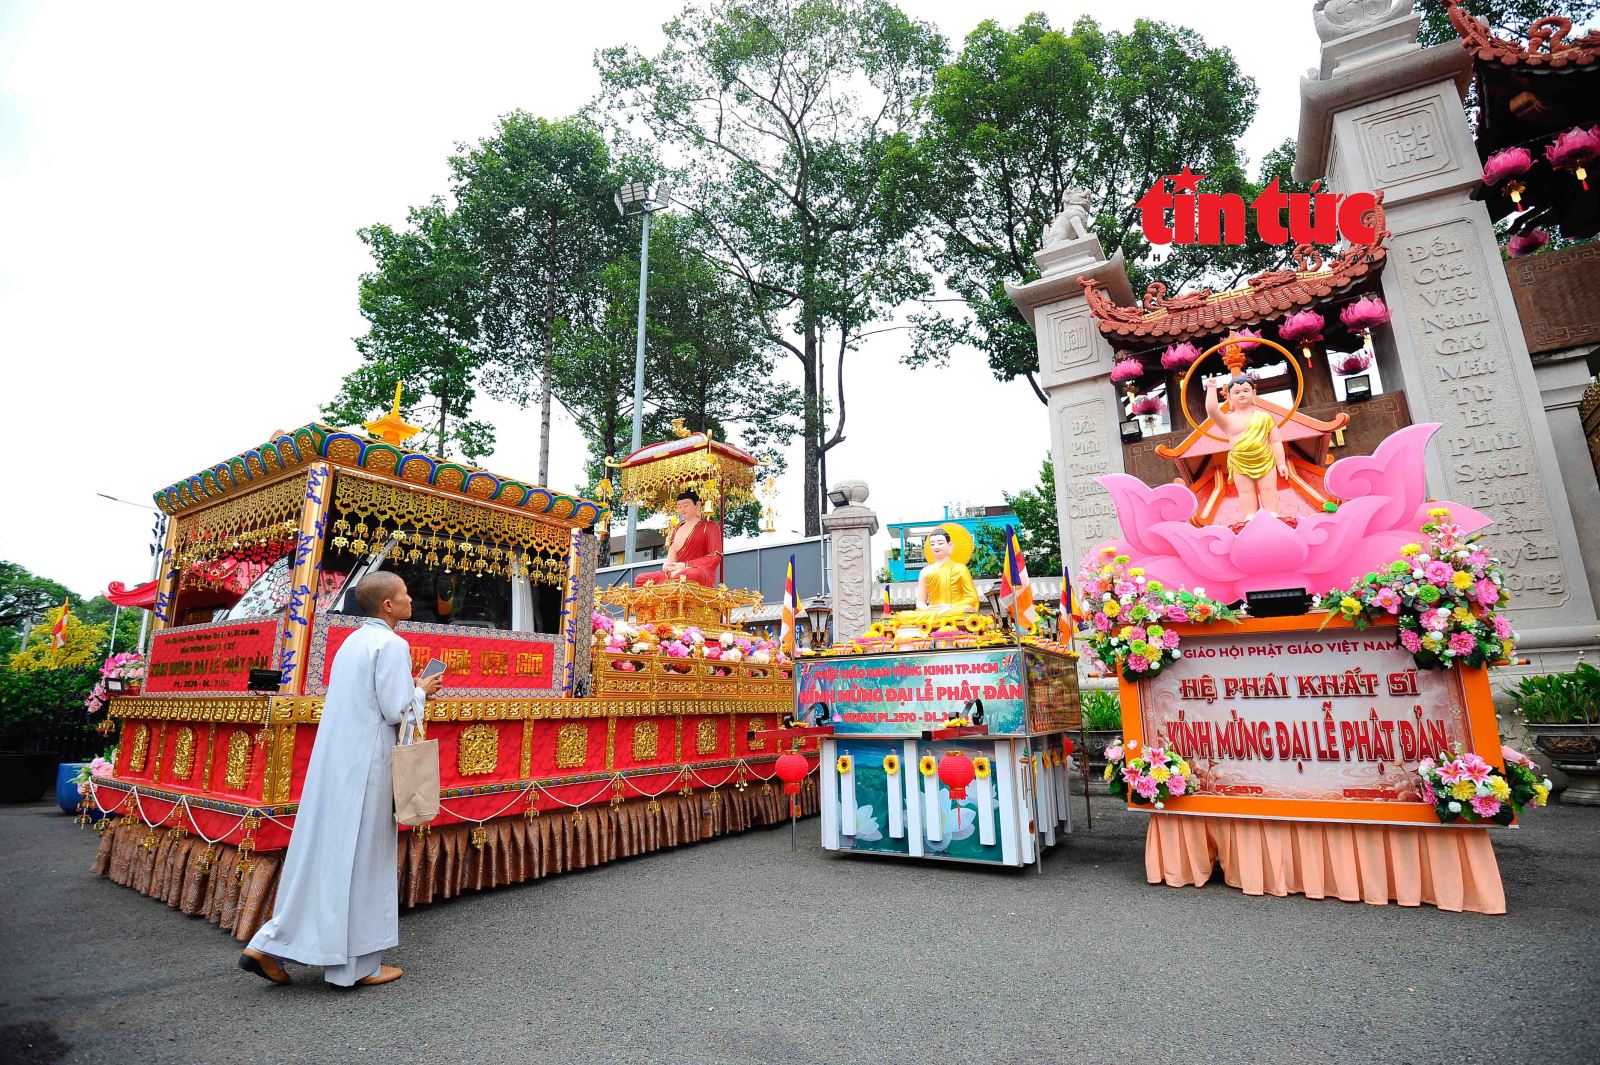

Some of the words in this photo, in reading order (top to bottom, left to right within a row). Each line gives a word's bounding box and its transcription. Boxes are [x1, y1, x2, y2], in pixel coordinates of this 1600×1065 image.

[1406, 236, 1463, 263] Đến
[1420, 286, 1478, 306] Việt
[1421, 311, 1490, 334] Nam
[1435, 332, 1487, 355] Gió
[1436, 357, 1497, 382] Mát
[1449, 385, 1494, 405] Từ
[1460, 410, 1496, 428] Bi
[1455, 459, 1529, 485] Sạch
[1183, 646, 1216, 659] GIÁO
[1219, 644, 1244, 659] HỘI
[1248, 644, 1283, 658] PHẬT
[1287, 641, 1324, 655] GIÁO
[1326, 640, 1360, 655] VIỆT
[1363, 641, 1399, 652] NAM
[813, 665, 839, 684] PHẬT
[841, 664, 865, 679] GIÁO
[867, 666, 891, 678] NAM
[893, 662, 922, 677] TÔNG
[923, 664, 954, 676] KINH
[954, 663, 999, 675] TP.HCM
[799, 684, 836, 704] KÍNH
[838, 683, 883, 702] MỪNG
[885, 687, 913, 707] ĐẠI
[916, 678, 934, 701] LỄ
[937, 679, 981, 705] PHẬT
[983, 678, 1023, 700] ĐẢN
[1179, 673, 1218, 704] HỆ
[1223, 672, 1291, 699] PHÁI
[1295, 666, 1379, 697] KHẤT
[1387, 667, 1421, 697] SĨ
[843, 712, 877, 723] VESAK
[1167, 709, 1214, 760] KÍNH
[1215, 709, 1275, 761] MỪNG
[1275, 720, 1312, 774] ĐẠI
[1312, 701, 1340, 762] LỄ
[1340, 706, 1396, 775] PHẬT
[1398, 704, 1449, 762] ĐẢN
